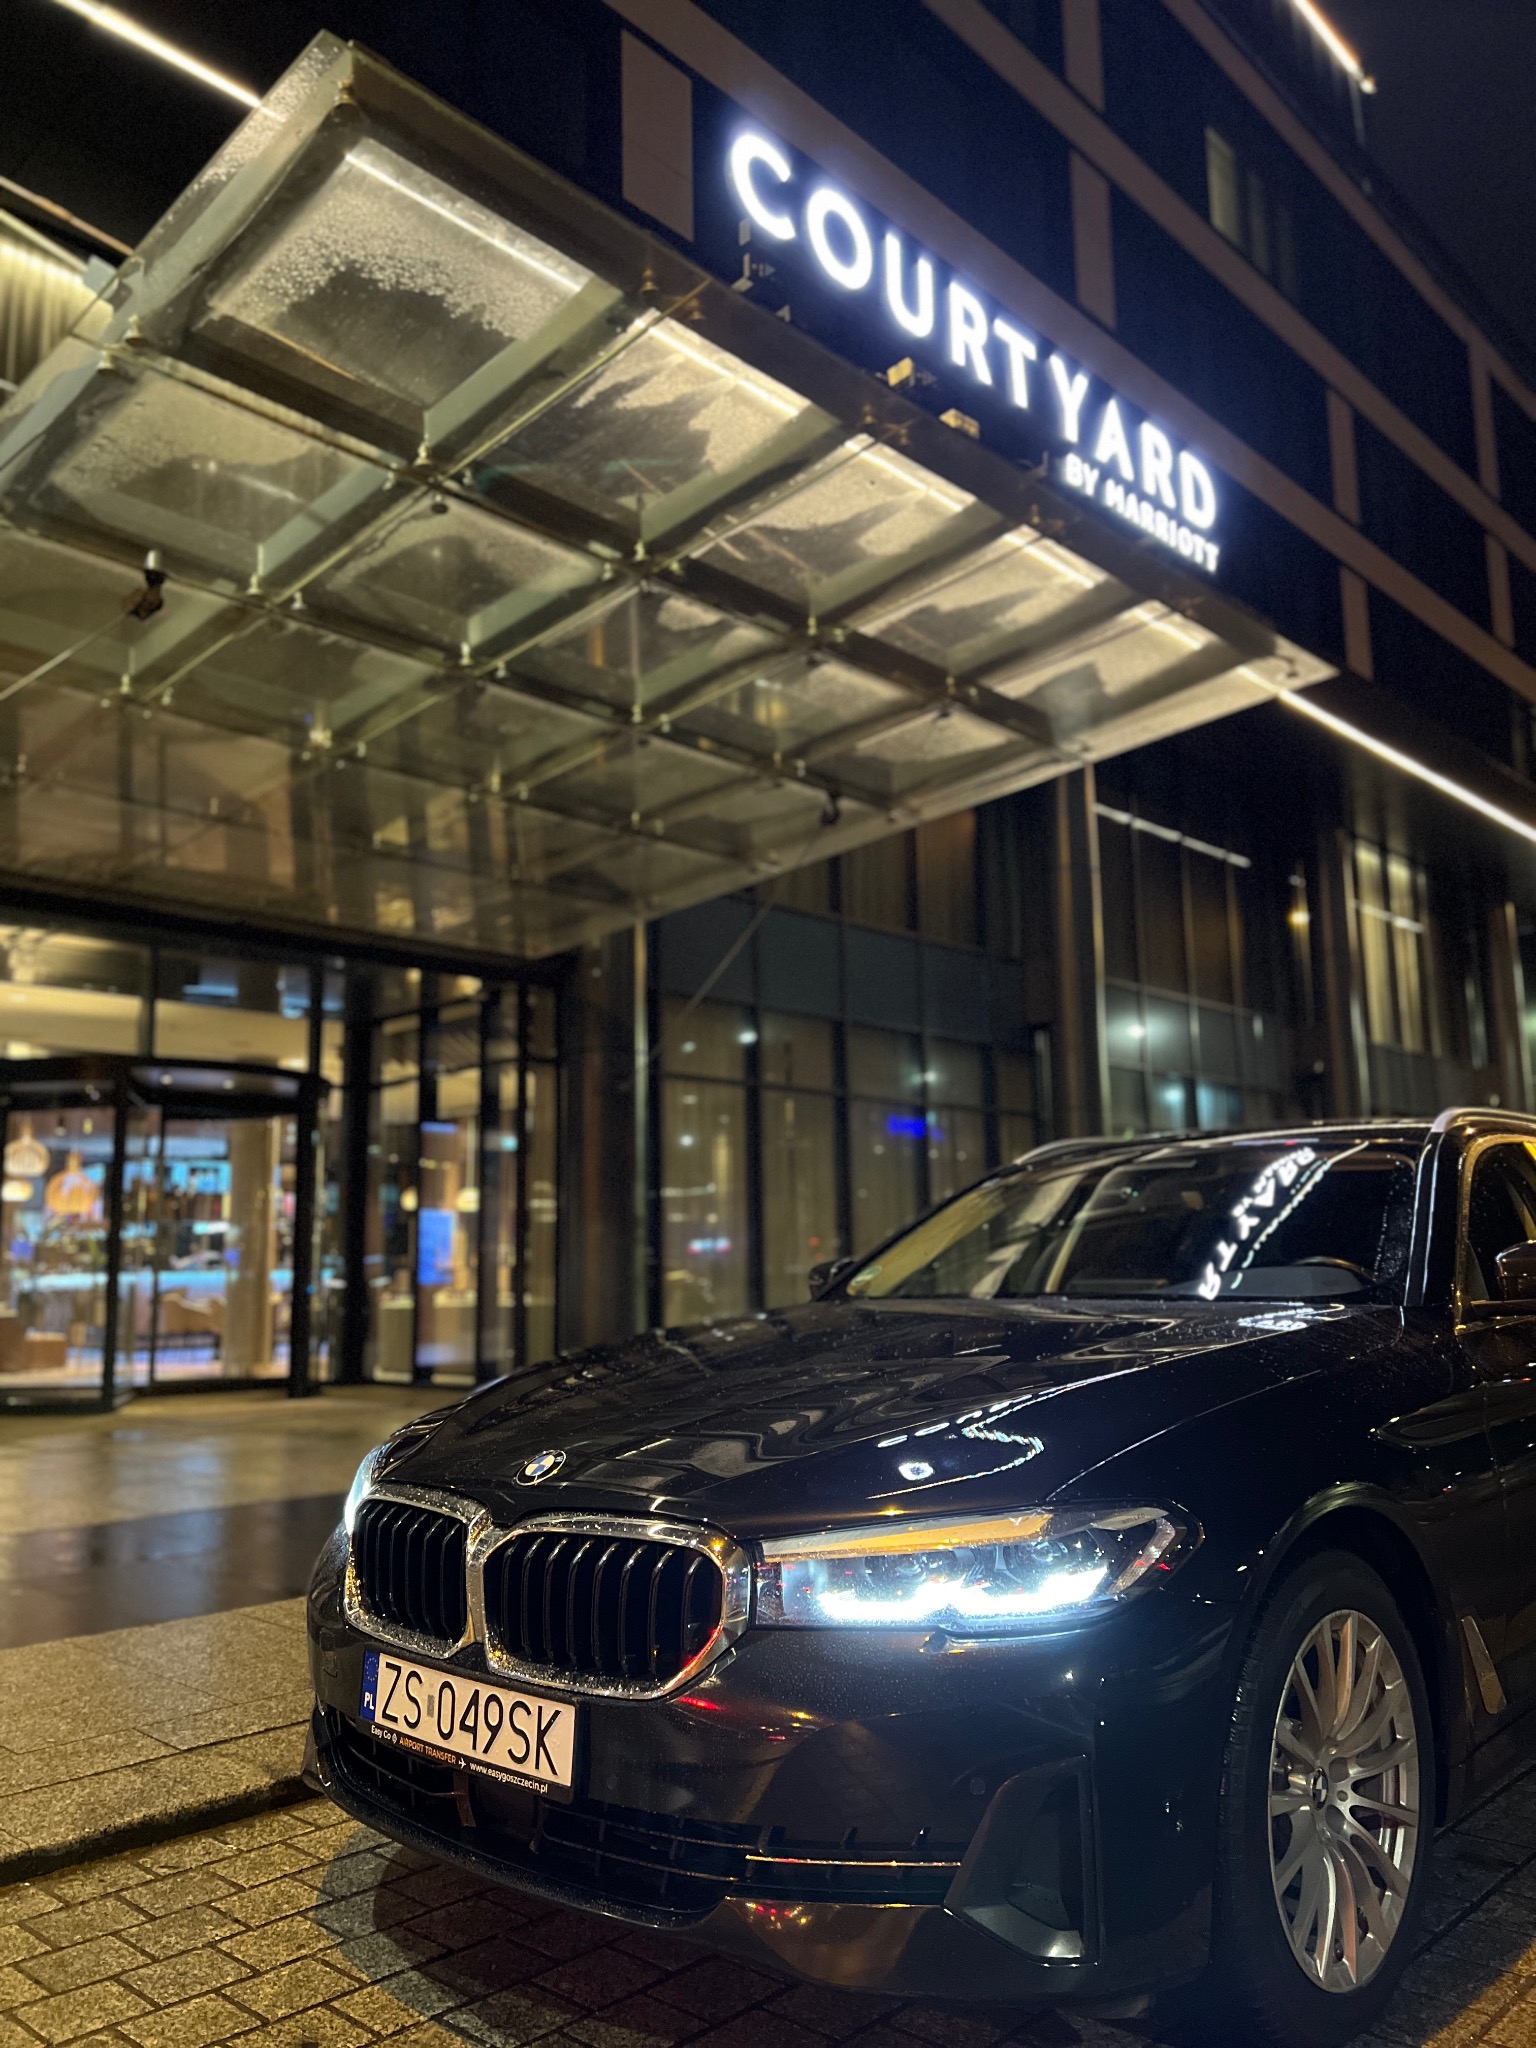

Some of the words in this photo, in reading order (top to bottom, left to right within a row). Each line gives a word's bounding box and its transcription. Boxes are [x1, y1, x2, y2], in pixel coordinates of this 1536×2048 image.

[730, 133, 1216, 529] COURTYARD
[1066, 453, 1099, 496] BY
[1105, 478, 1220, 574] MARRIOTT
[364, 1691, 375, 1710] PL
[382, 1661, 423, 1730] ZS
[437, 1681, 561, 1776] 049SK
[371, 1724, 383, 1739] Easy
[399, 1736, 424, 1753] AIRPORT
[425, 1745, 456, 1765] TRANSFER
[469, 1762, 548, 1793] www.easygoszczecin.pl
